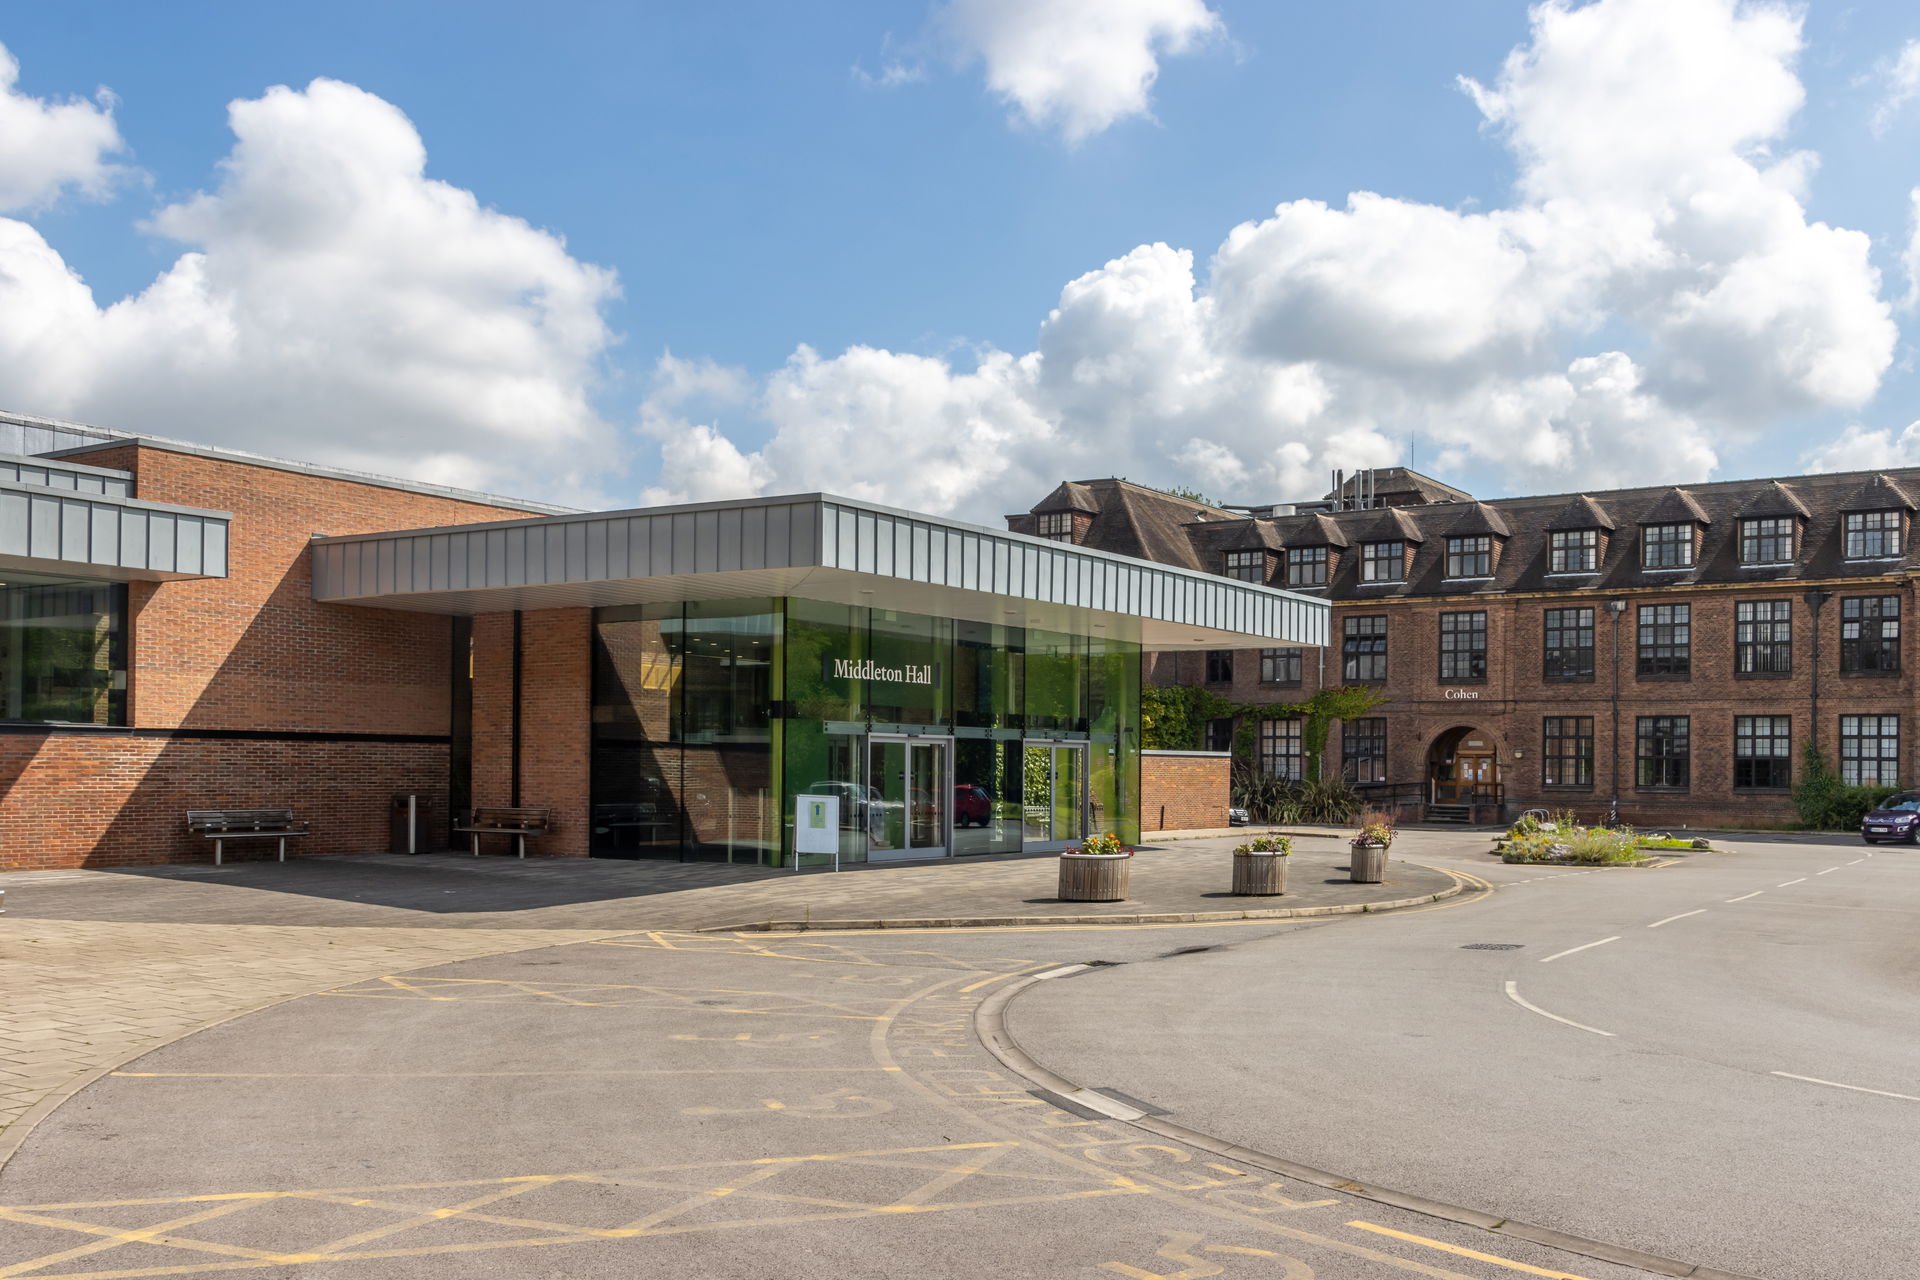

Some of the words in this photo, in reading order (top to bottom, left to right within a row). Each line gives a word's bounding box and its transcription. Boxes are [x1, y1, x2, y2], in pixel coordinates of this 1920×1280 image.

[834, 658, 902, 682] Middleton
[905, 664, 931, 684] Hall
[1445, 689, 1478, 699] Cohen
